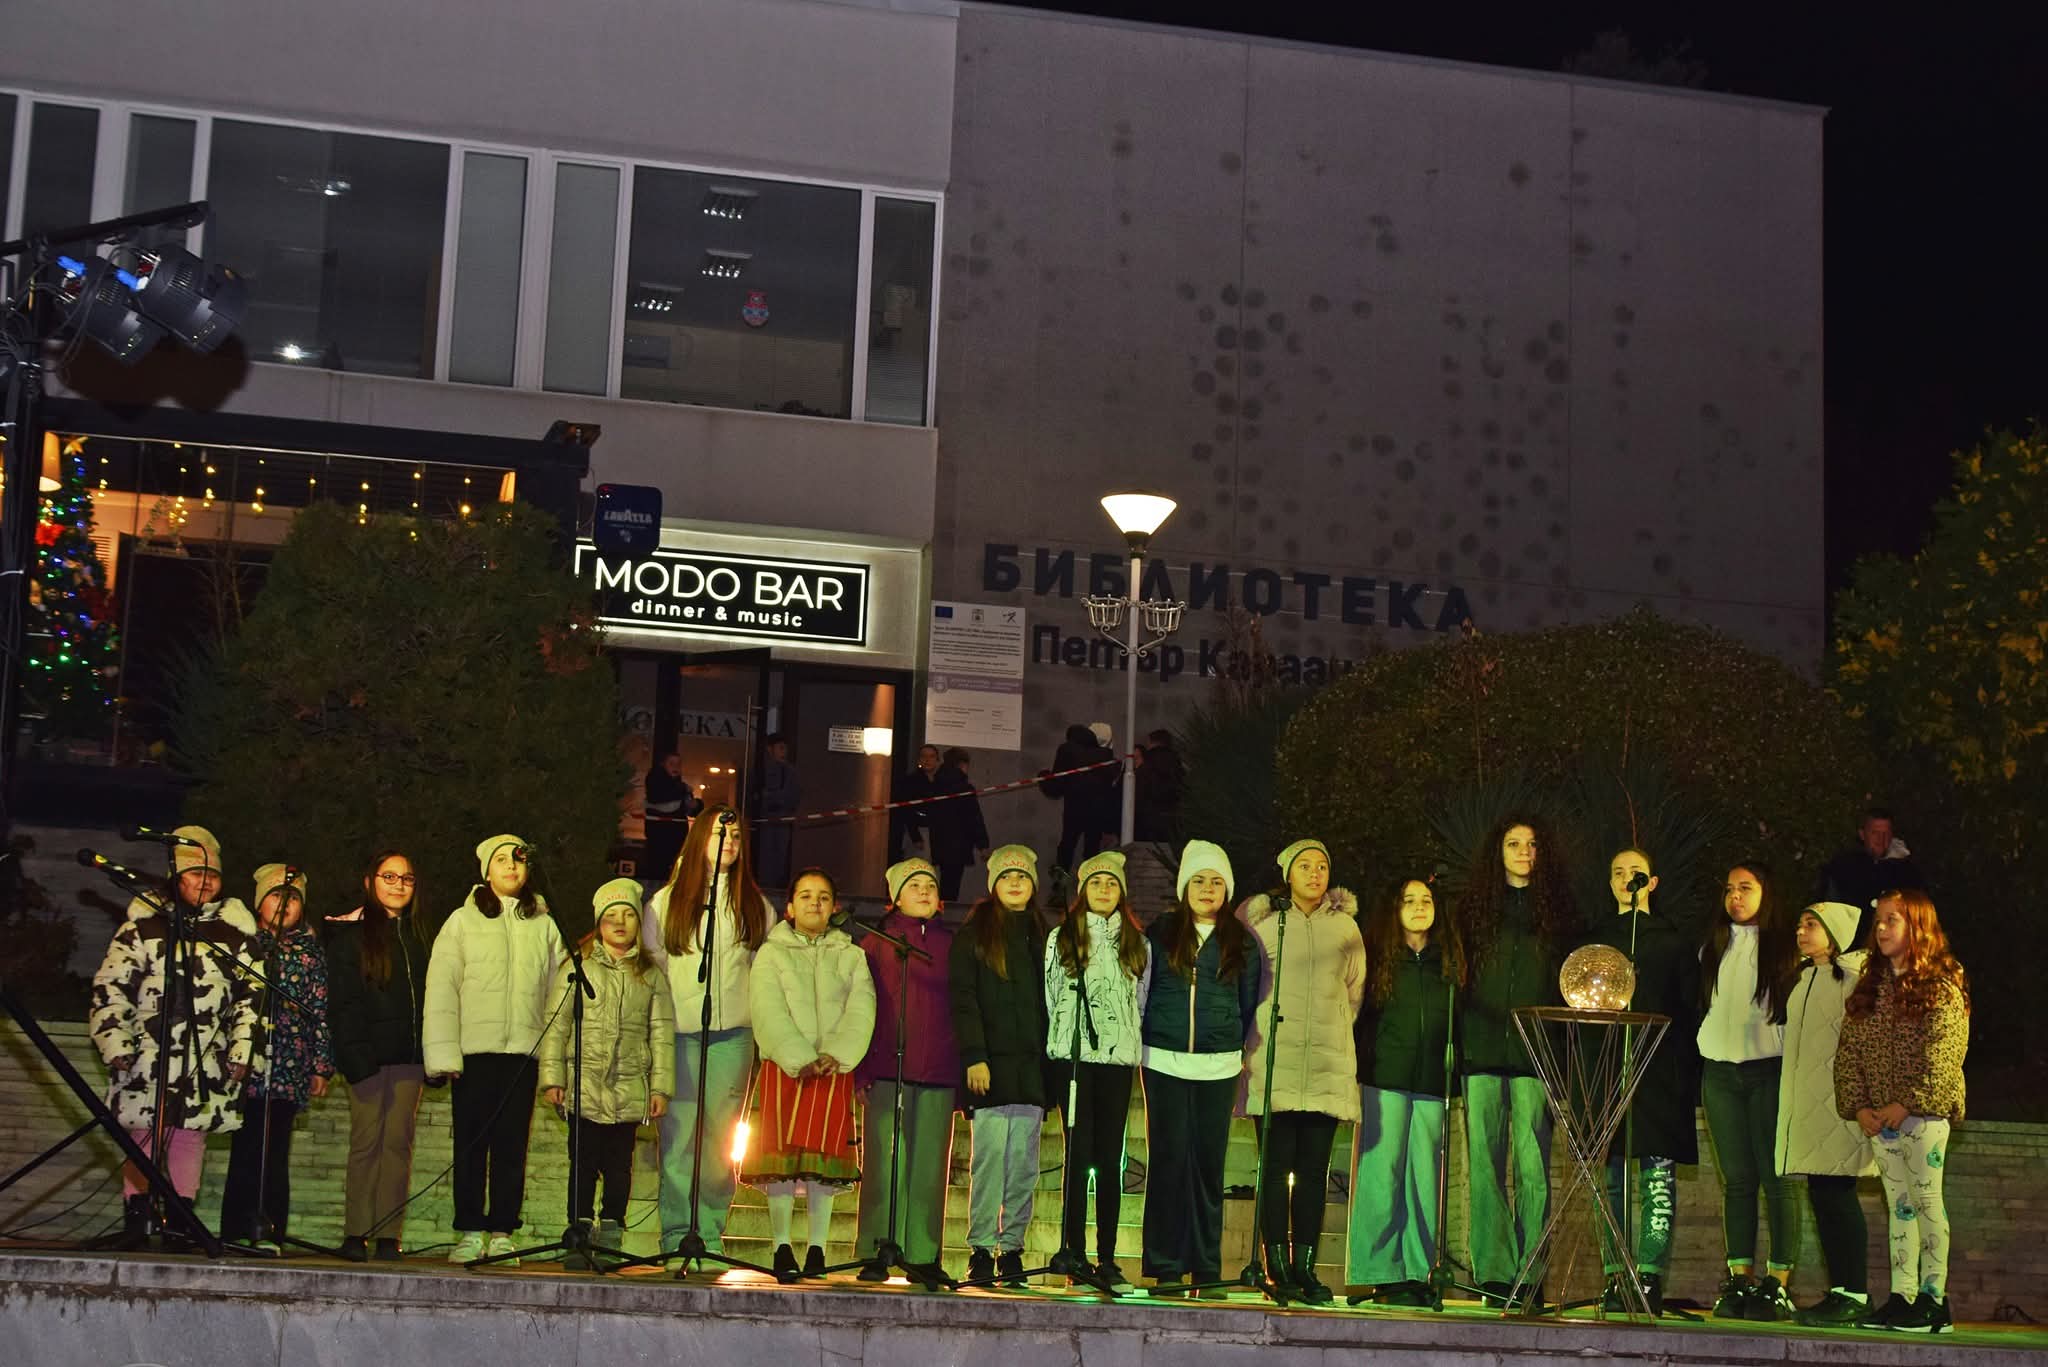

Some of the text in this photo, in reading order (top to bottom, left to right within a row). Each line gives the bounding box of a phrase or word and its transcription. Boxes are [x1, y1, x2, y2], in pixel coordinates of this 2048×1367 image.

[595, 557, 844, 611] MODO BAR
[983, 543, 1475, 633] БИБЛИОТЕКА
[631, 599, 803, 628] dinner & music
